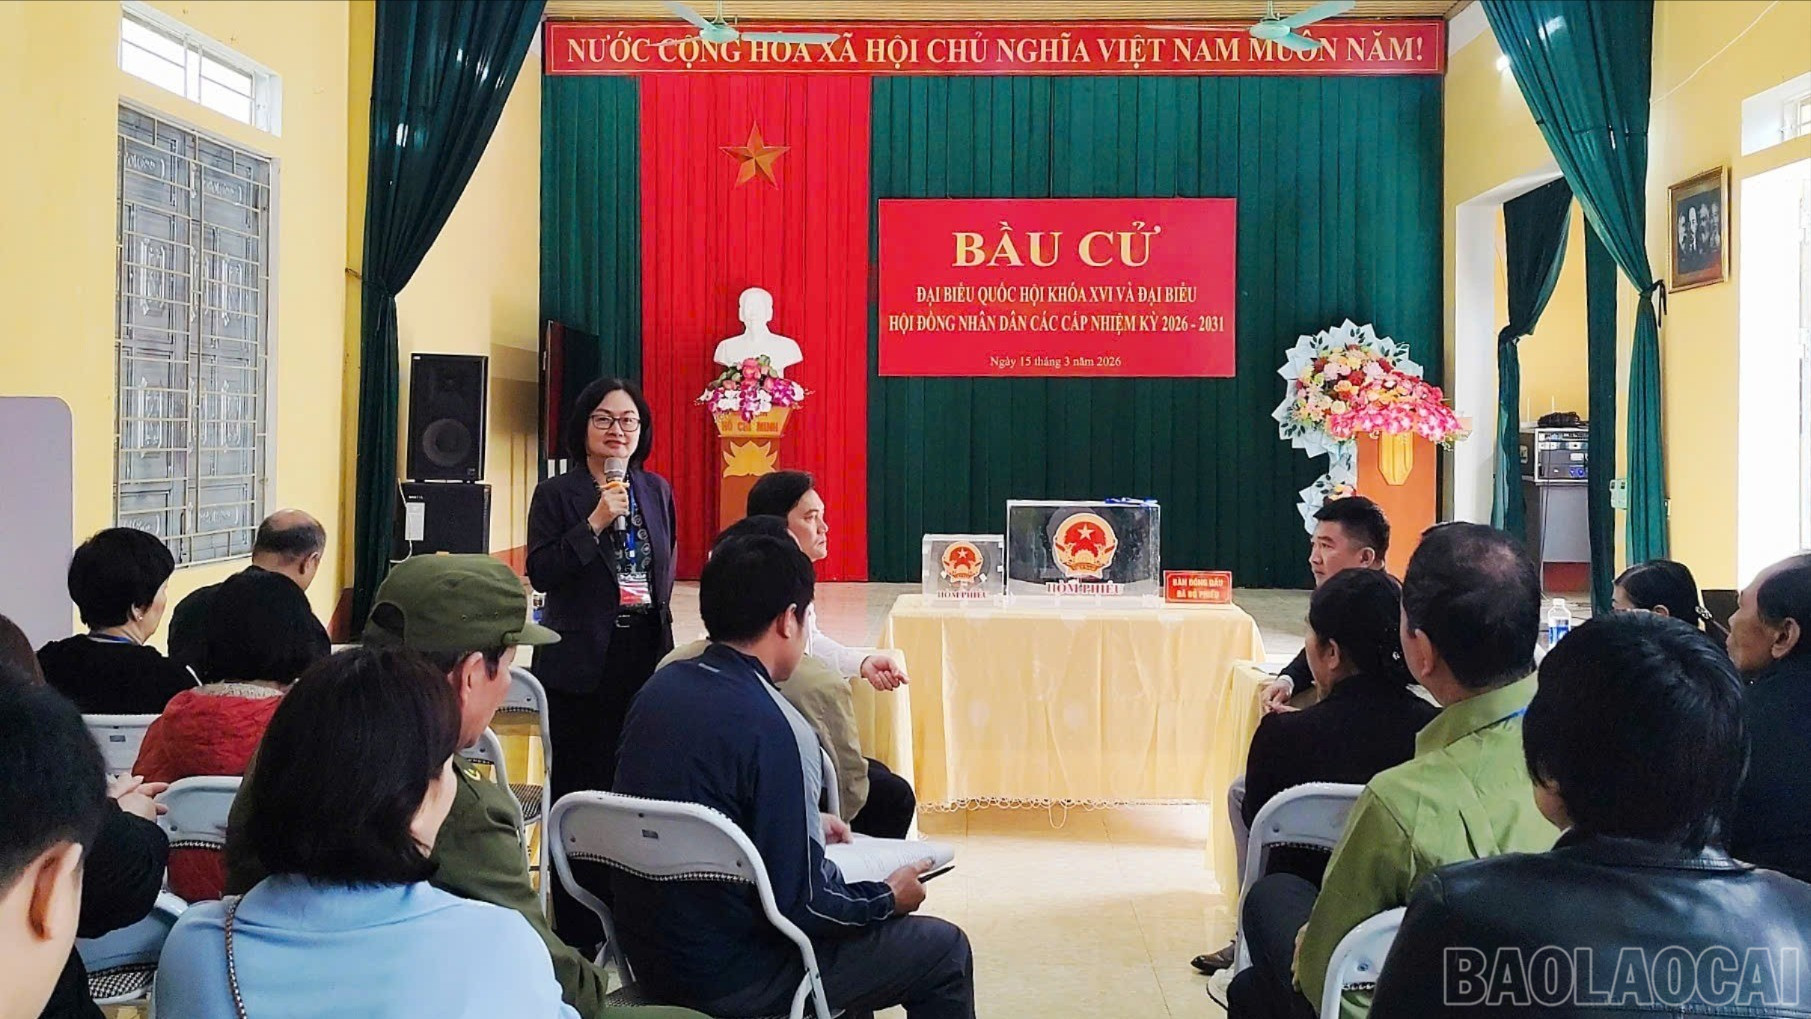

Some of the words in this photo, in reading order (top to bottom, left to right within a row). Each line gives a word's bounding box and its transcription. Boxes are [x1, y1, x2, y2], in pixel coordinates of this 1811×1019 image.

[567, 31, 651, 62] NƯỚC
[658, 34, 741, 69] CỘNG
[817, 32, 858, 62] XÃ
[865, 35, 919, 69] HỘI
[927, 31, 989, 62] CHỦ
[996, 32, 1091, 62] NGHĨA
[1096, 34, 1166, 69] VIỆT
[1172, 37, 1240, 62] NAM
[1345, 30, 1424, 62] NĂM!
[951, 221, 1064, 267] BẦU
[1078, 221, 1162, 267] CỬ
[916, 285, 940, 306] ĐẠI
[977, 281, 1017, 306] QUỐC
[1019, 283, 1045, 307] HỘI
[1048, 281, 1087, 303] KHÓA
[1089, 286, 1113, 303] XVI
[1116, 281, 1135, 303] VÀ
[1138, 286, 1162, 307] ĐẠI
[889, 312, 914, 335] HỘI
[916, 310, 956, 332] ĐỒNG
[958, 310, 997, 332] NHÂN
[999, 310, 1028, 332] DÂN
[1029, 310, 1059, 332] CÁC
[1061, 310, 1089, 332] CẤP
[1090, 312, 1136, 336] NHIỆM
[1139, 310, 1159, 332] KỲ
[1161, 315, 1188, 332] 2026
[1198, 315, 1224, 332] 2031
[990, 356, 1016, 369] Ngày
[1020, 356, 1032, 367] 15
[1034, 356, 1062, 369] tháng
[1064, 356, 1071, 367] 3
[1073, 356, 1094, 367] năm
[1096, 356, 1122, 367] 2026
